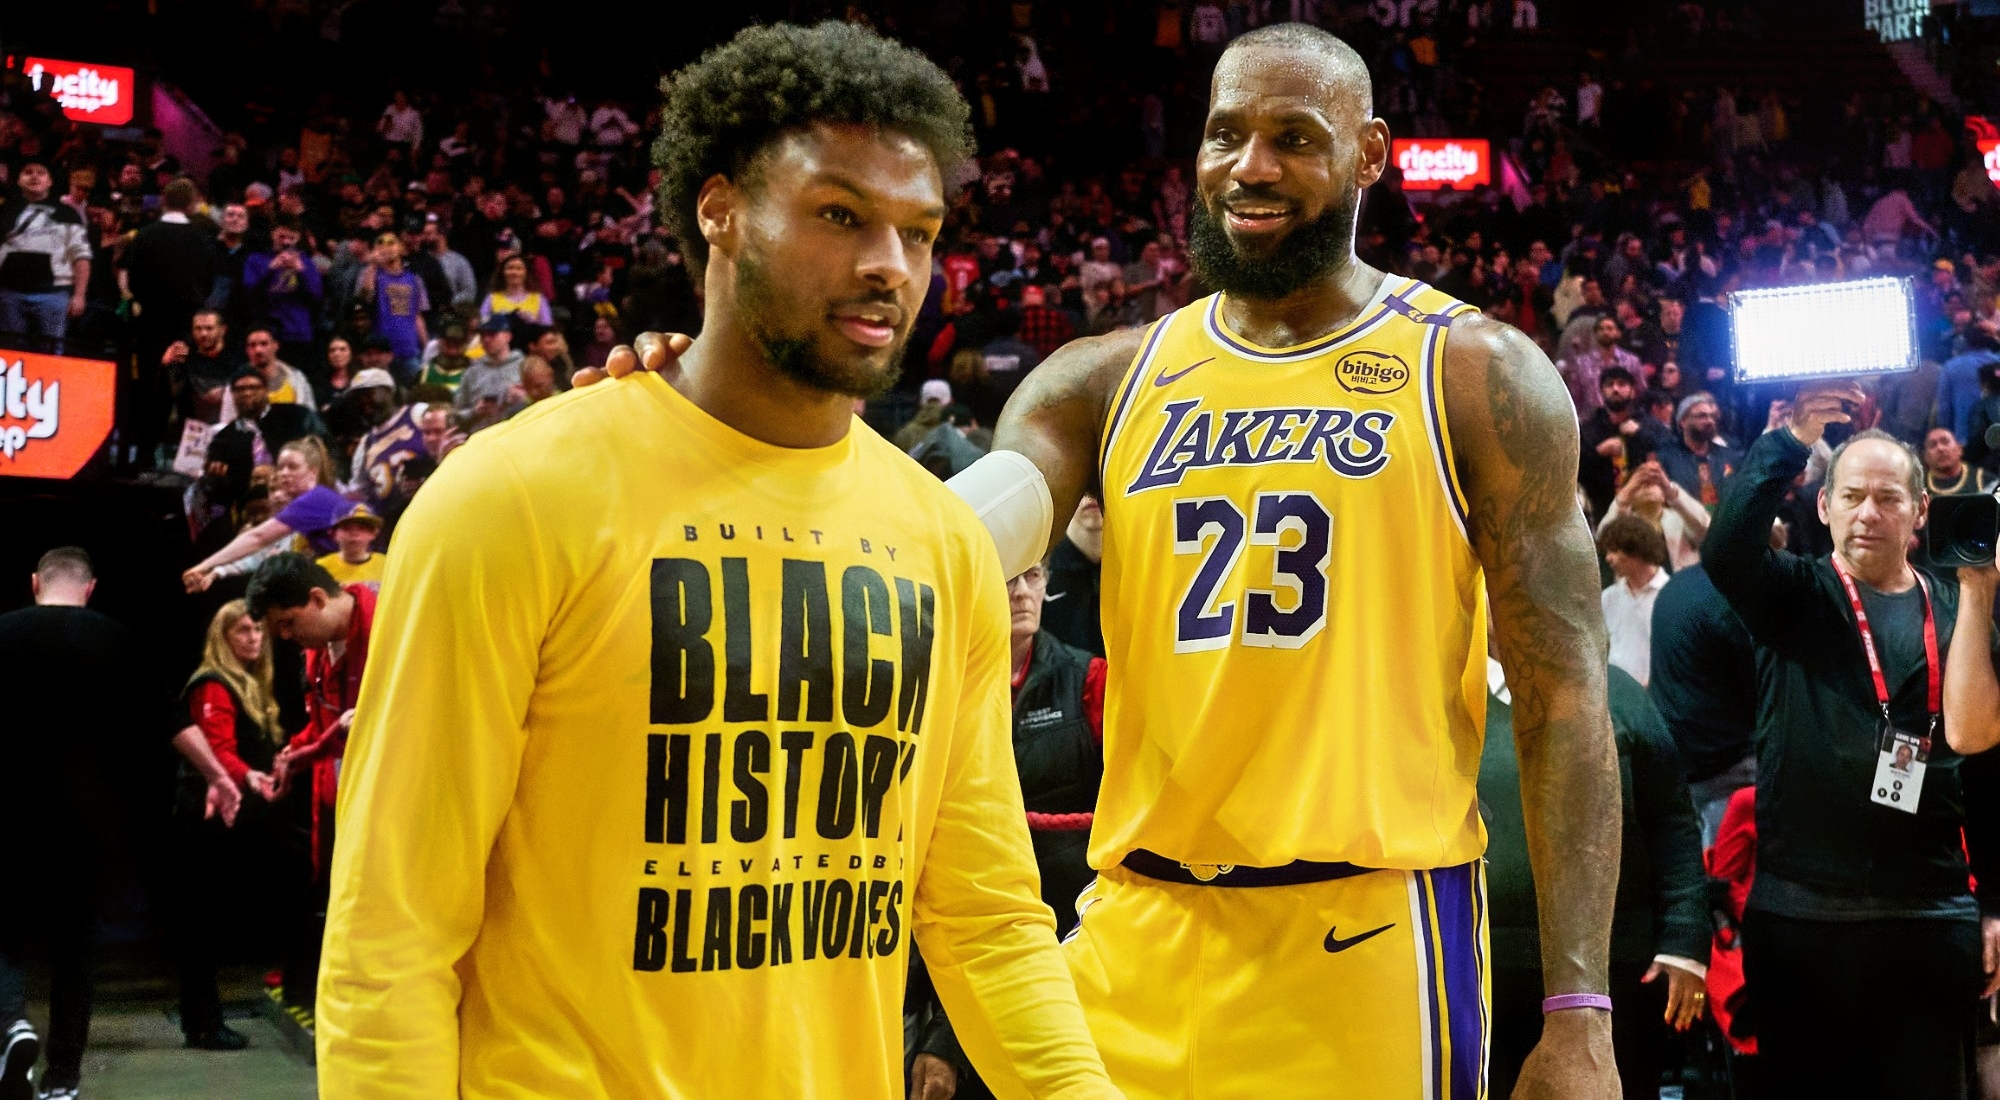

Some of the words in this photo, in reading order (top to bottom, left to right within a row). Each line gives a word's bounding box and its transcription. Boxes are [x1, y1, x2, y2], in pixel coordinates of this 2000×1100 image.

[1398, 143, 1479, 176] ripcity
[1342, 360, 1405, 383] bibigo
[1351, 375, 1377, 385] 비비고
[1124, 396, 1396, 497] LAKERS
[684, 523, 823, 545] BUILT
[860, 537, 896, 561] BY
[1173, 488, 1335, 655] 23
[650, 557, 935, 736] BLACK
[872, 854, 903, 870] B
[633, 883, 795, 974] BLACK
